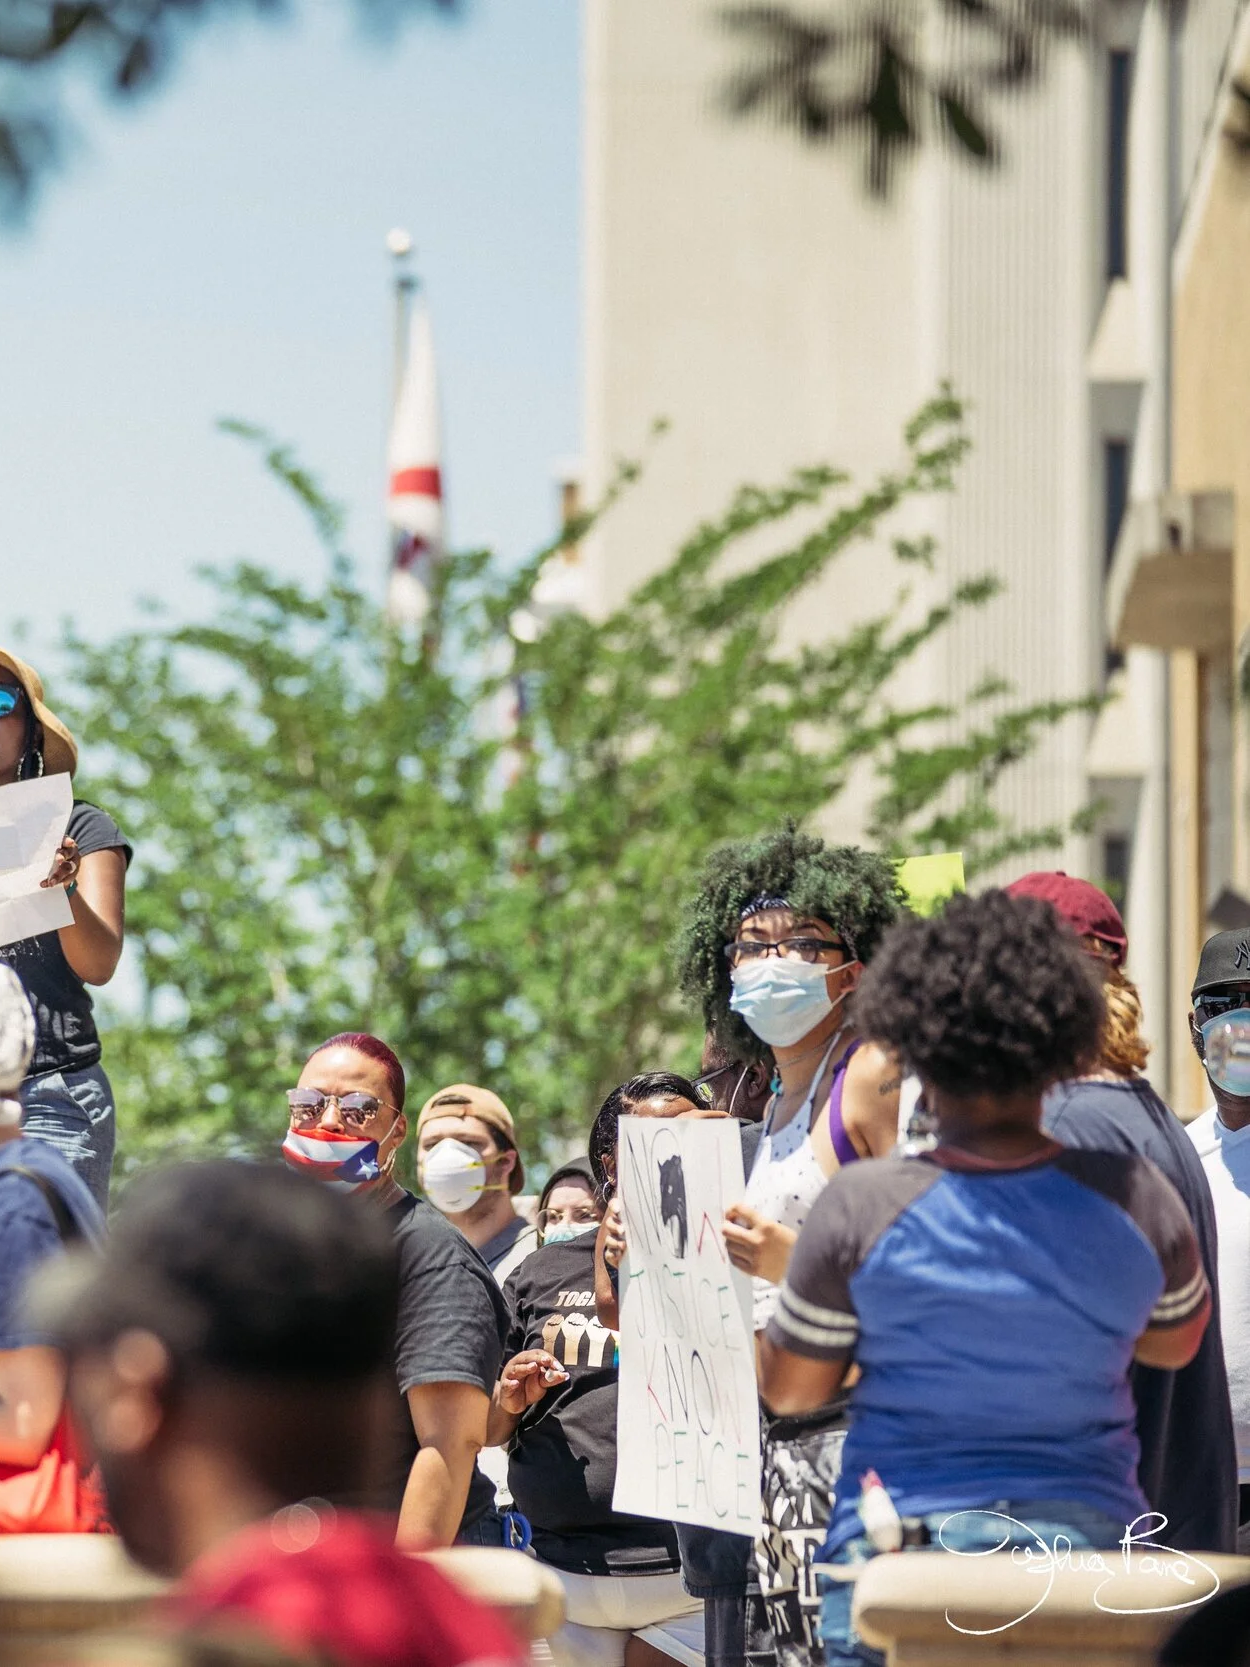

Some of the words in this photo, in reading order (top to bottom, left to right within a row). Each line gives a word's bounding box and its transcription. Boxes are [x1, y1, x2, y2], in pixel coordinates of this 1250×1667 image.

[630, 1263, 741, 1351] JUSTICE
[642, 1340, 741, 1445] KNOW
[654, 1422, 751, 1521] PEACE
